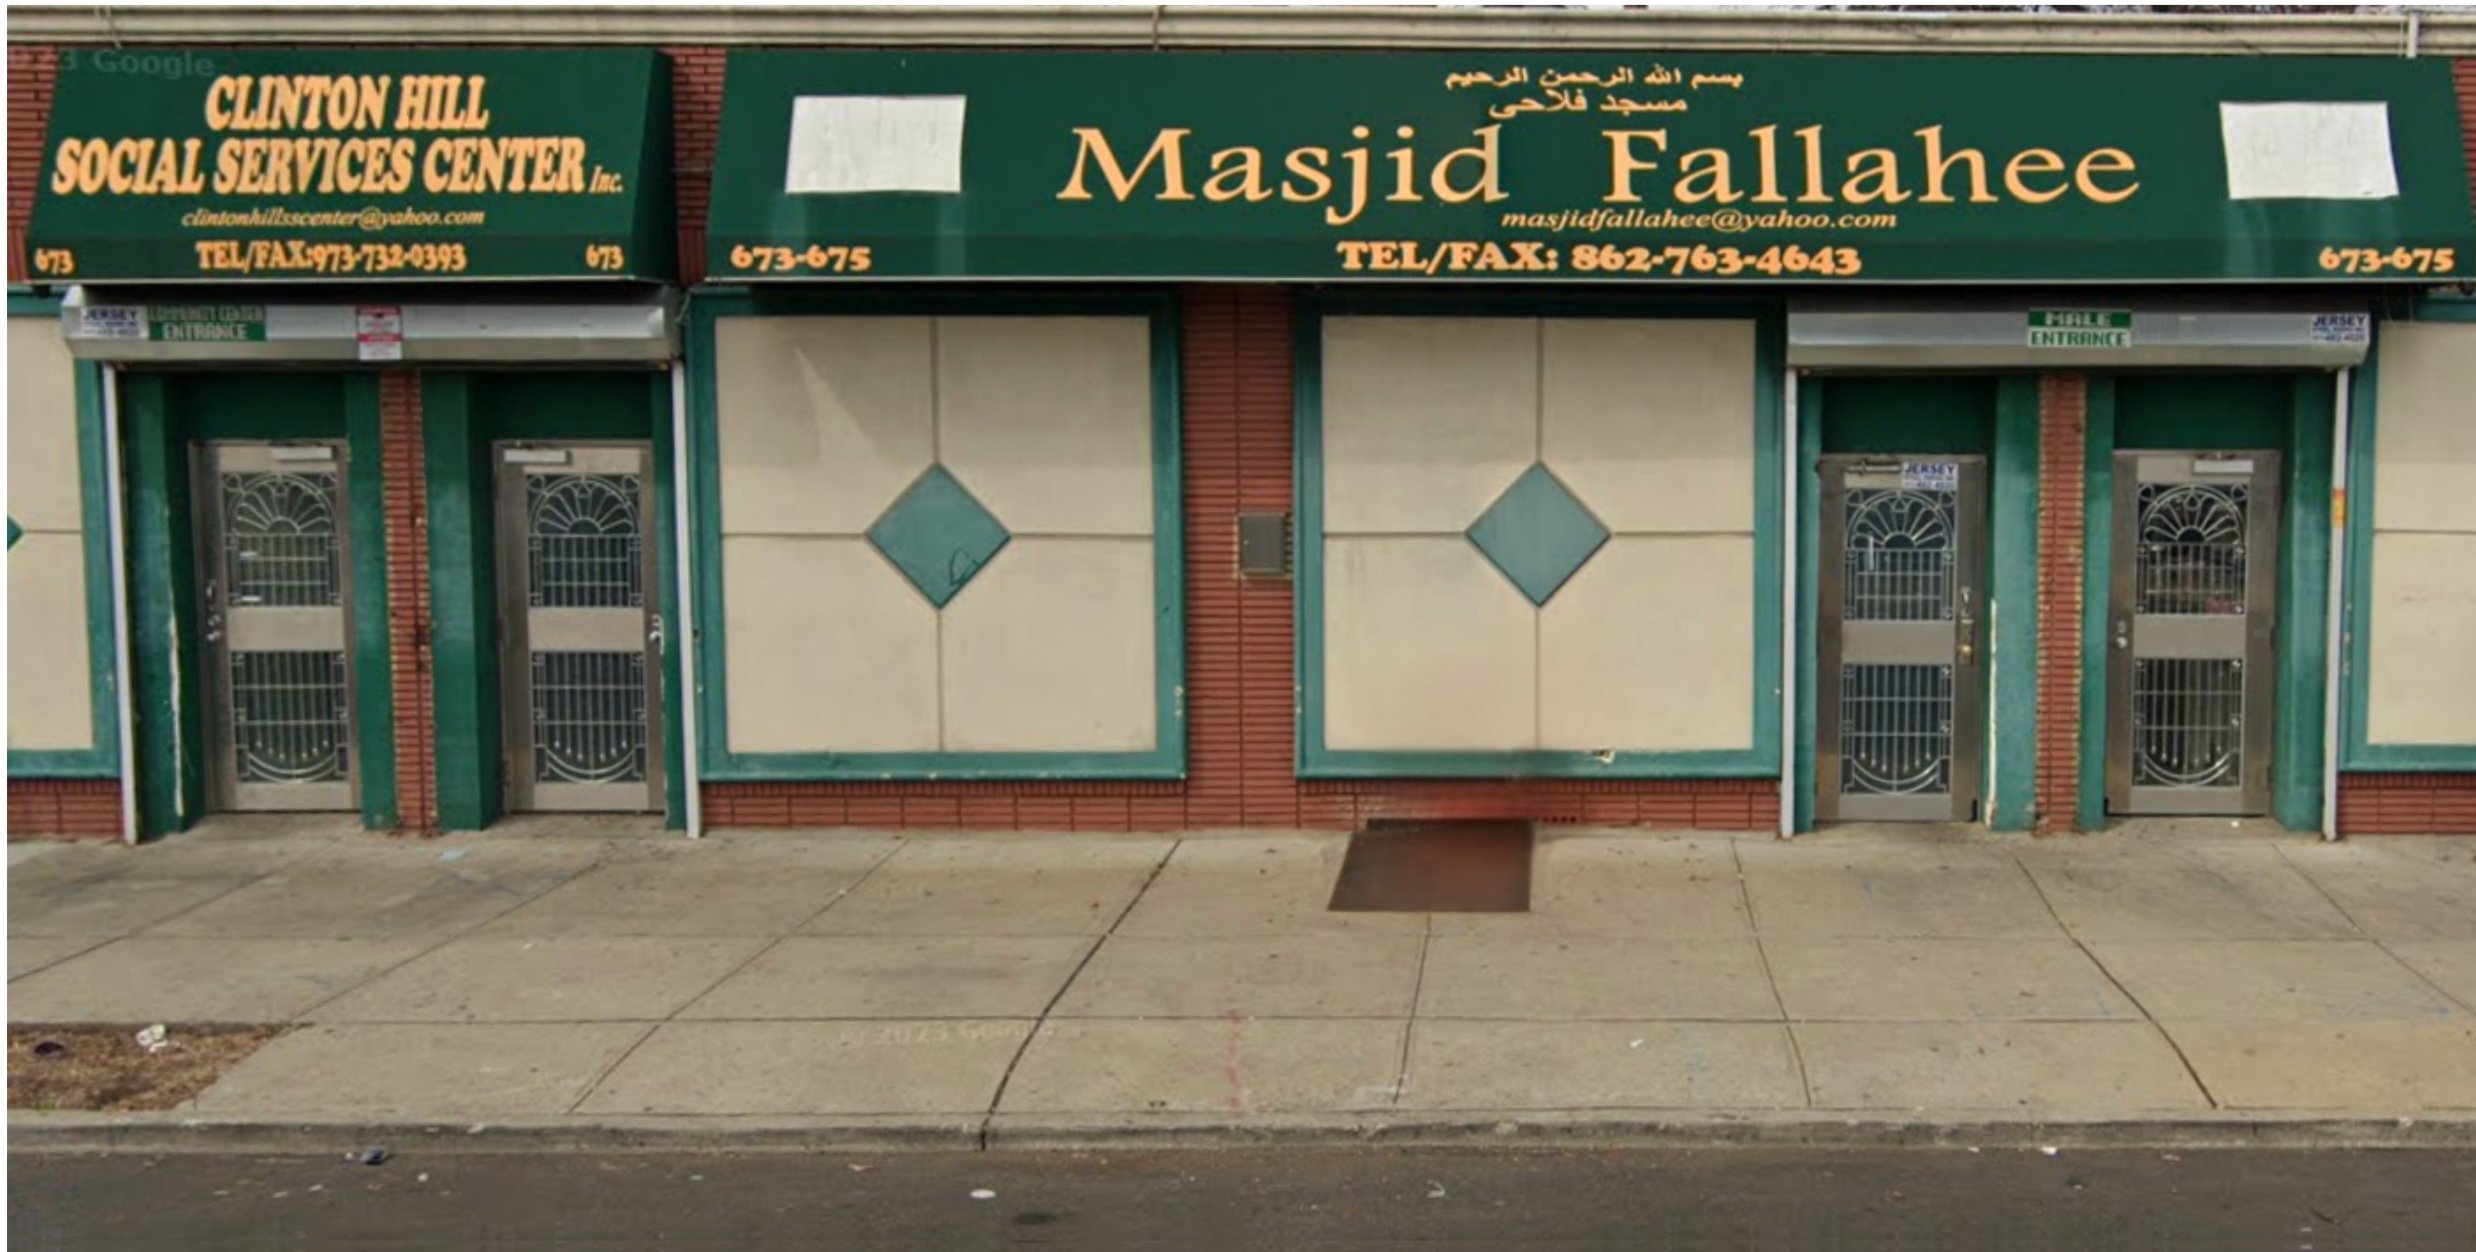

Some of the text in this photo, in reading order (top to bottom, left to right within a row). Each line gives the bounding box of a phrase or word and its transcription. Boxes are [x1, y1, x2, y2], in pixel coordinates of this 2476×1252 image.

[1445, 65, 1528, 90] الرحيم
[1539, 65, 1635, 88] الرحمن
[1643, 64, 1681, 85] الله
[205, 74, 490, 131] CLINTON HILL
[1599, 94, 1688, 117] مسجد
[52, 136, 624, 195] SOCIAL SERVICES CENTER Inc.
[1056, 123, 2140, 226] Masjid Fallahee
[181, 205, 486, 231] clintonhillsscenter@yahoo.com
[1501, 207, 1897, 233] masjidfallahee@yahoo.com
[34, 247, 75, 275] 673
[585, 244, 625, 271] 673
[730, 244, 872, 272] 673-675
[1336, 240, 1862, 276] TEL/FAX: 862-763-4643
[2318, 246, 2455, 274] 673-675
[163, 322, 248, 340] ENTRANCE
[2045, 311, 2112, 327] MALE
[2313, 314, 2365, 327] JERSEY
[2031, 330, 2127, 346] ENTRANCE
[1905, 464, 1955, 475] JERSEY
